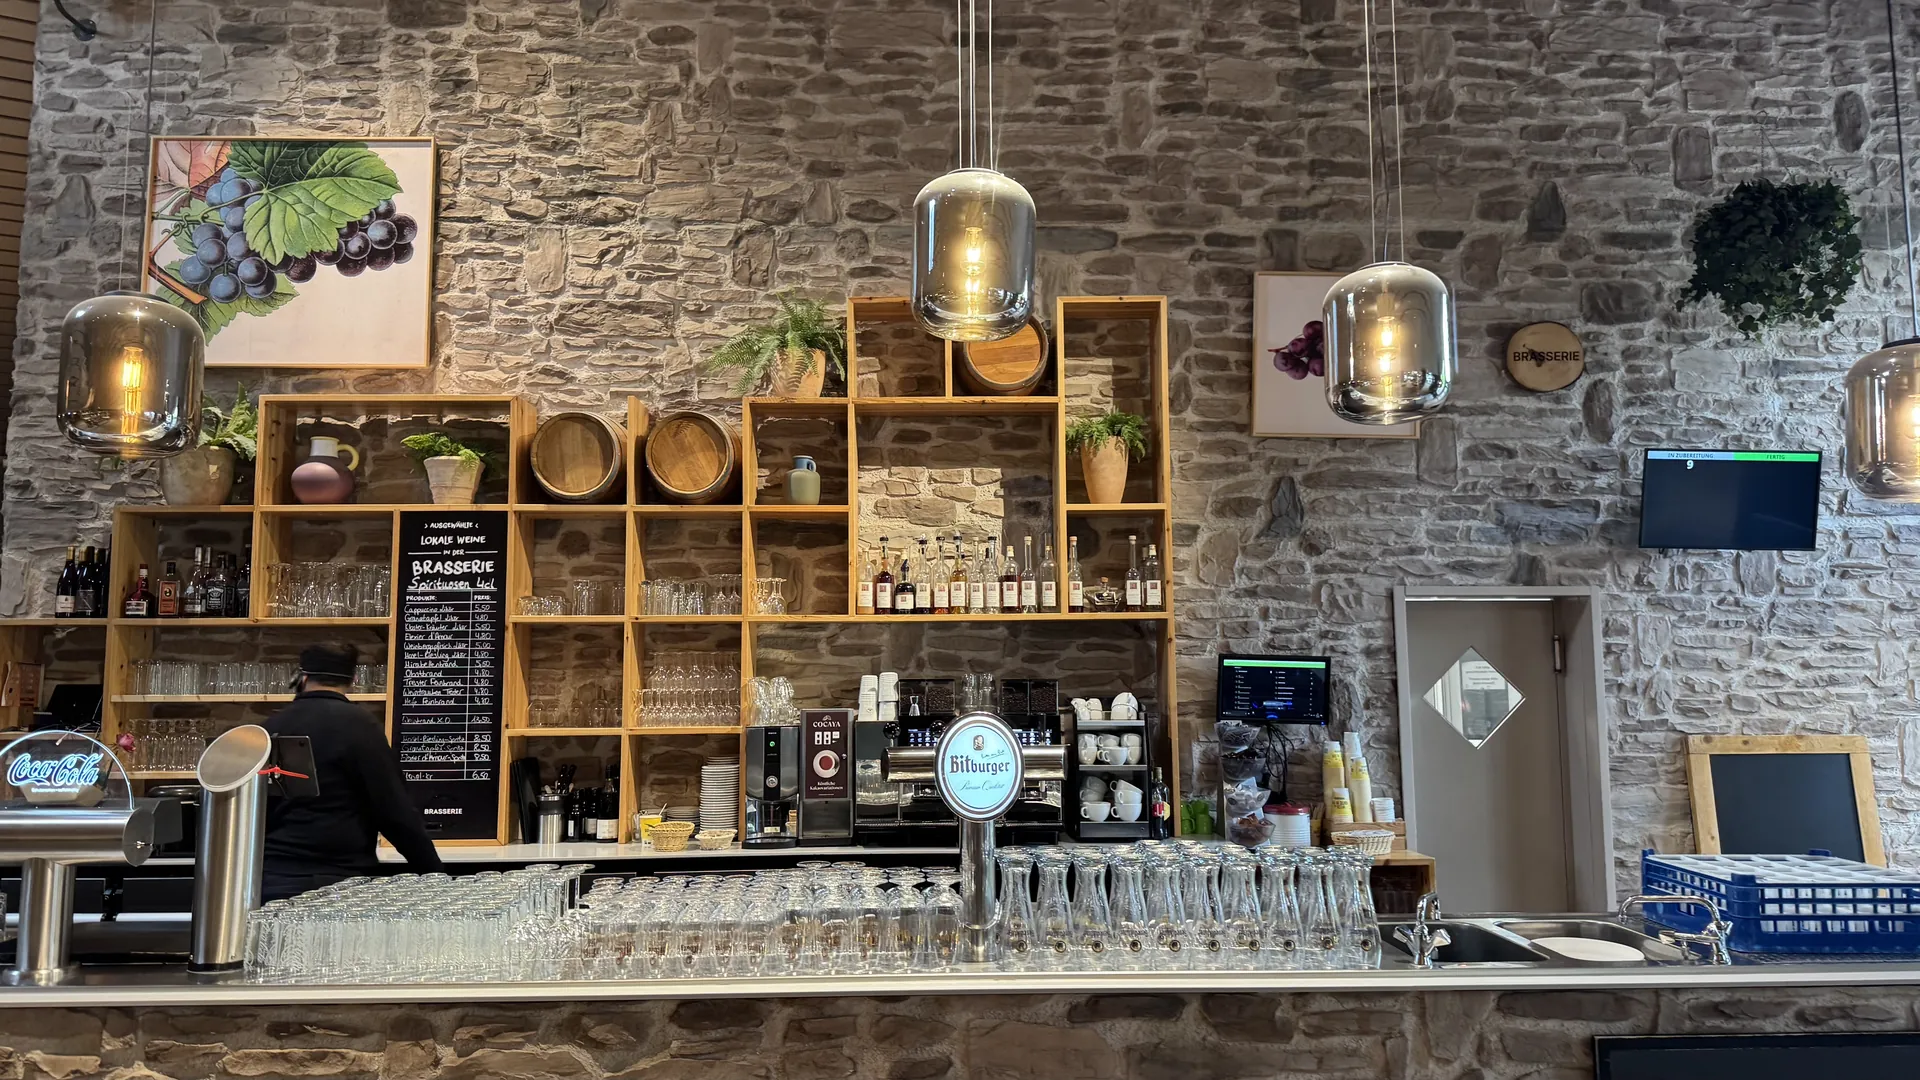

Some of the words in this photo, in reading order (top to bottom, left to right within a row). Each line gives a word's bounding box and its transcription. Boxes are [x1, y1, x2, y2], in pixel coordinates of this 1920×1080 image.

[1513, 351, 1580, 361] BRASSERIE
[1686, 460, 1694, 470] 9
[430, 521, 473, 529] AUSGEWÄHLTE
[421, 535, 453, 546] LOKALE
[457, 535, 486, 544] WEINE
[412, 560, 495, 576] BRASSERIE
[408, 576, 471, 594] Spirituosen
[476, 577, 495, 590] 4cl
[7, 753, 104, 787] Coca-Cola
[949, 755, 1011, 776] Bitburger
